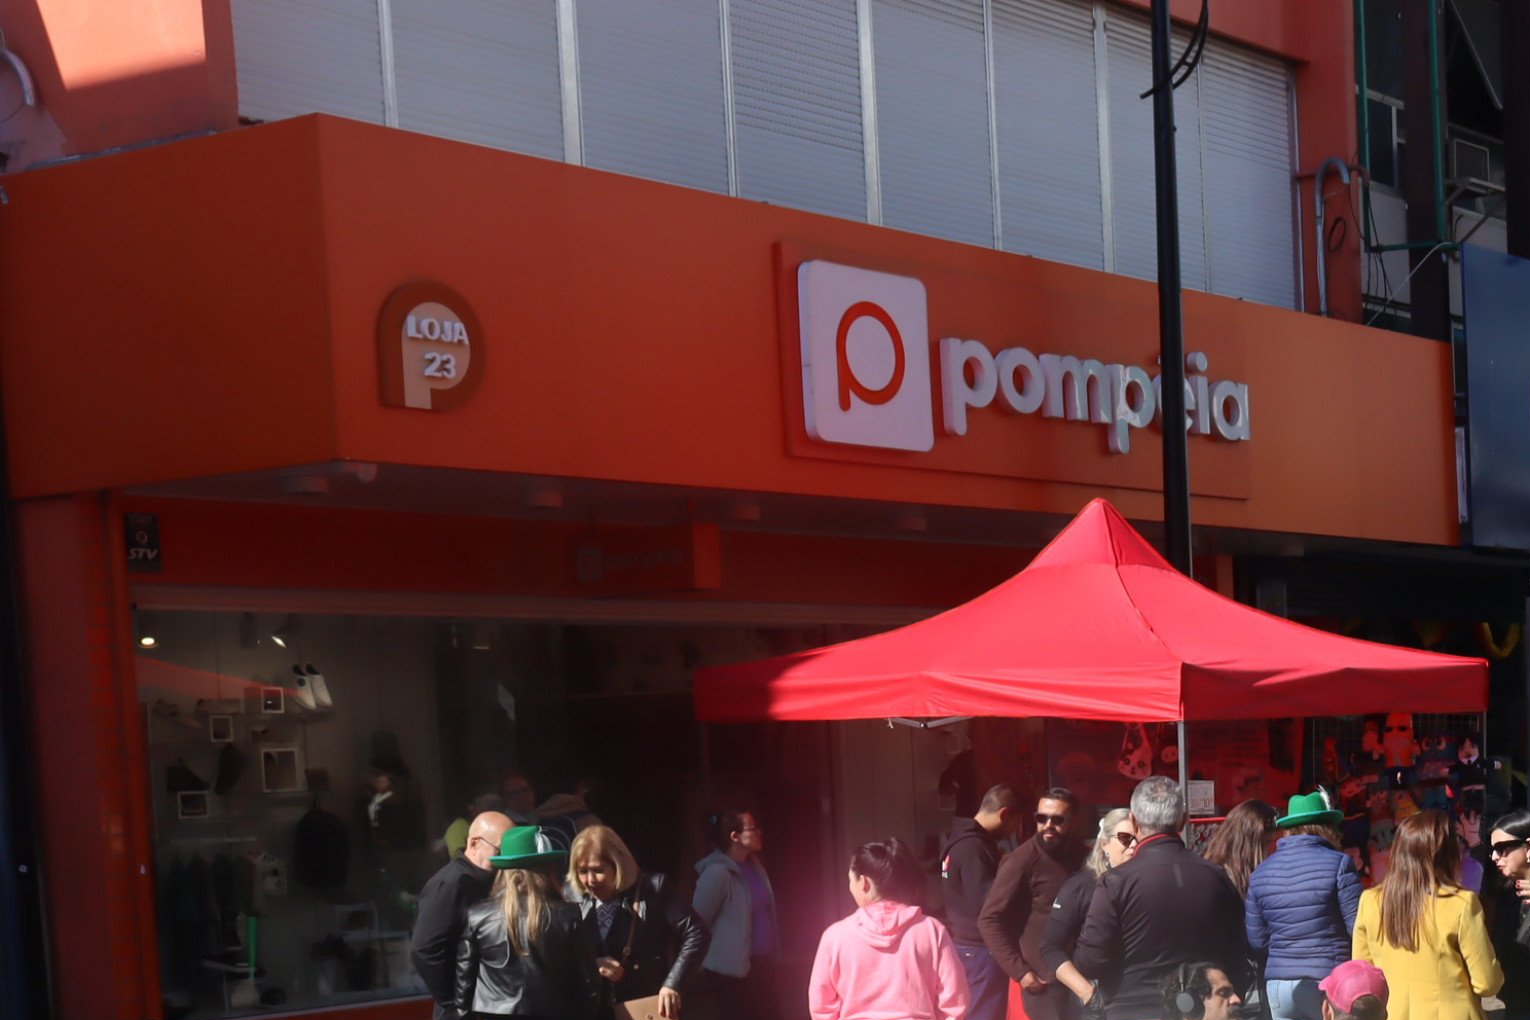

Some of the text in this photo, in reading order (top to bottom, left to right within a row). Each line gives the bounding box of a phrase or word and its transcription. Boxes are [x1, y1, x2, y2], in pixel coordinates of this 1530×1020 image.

[406, 315, 469, 345] LOJA
[424, 351, 458, 379] 23
[128, 548, 159, 560] STV
